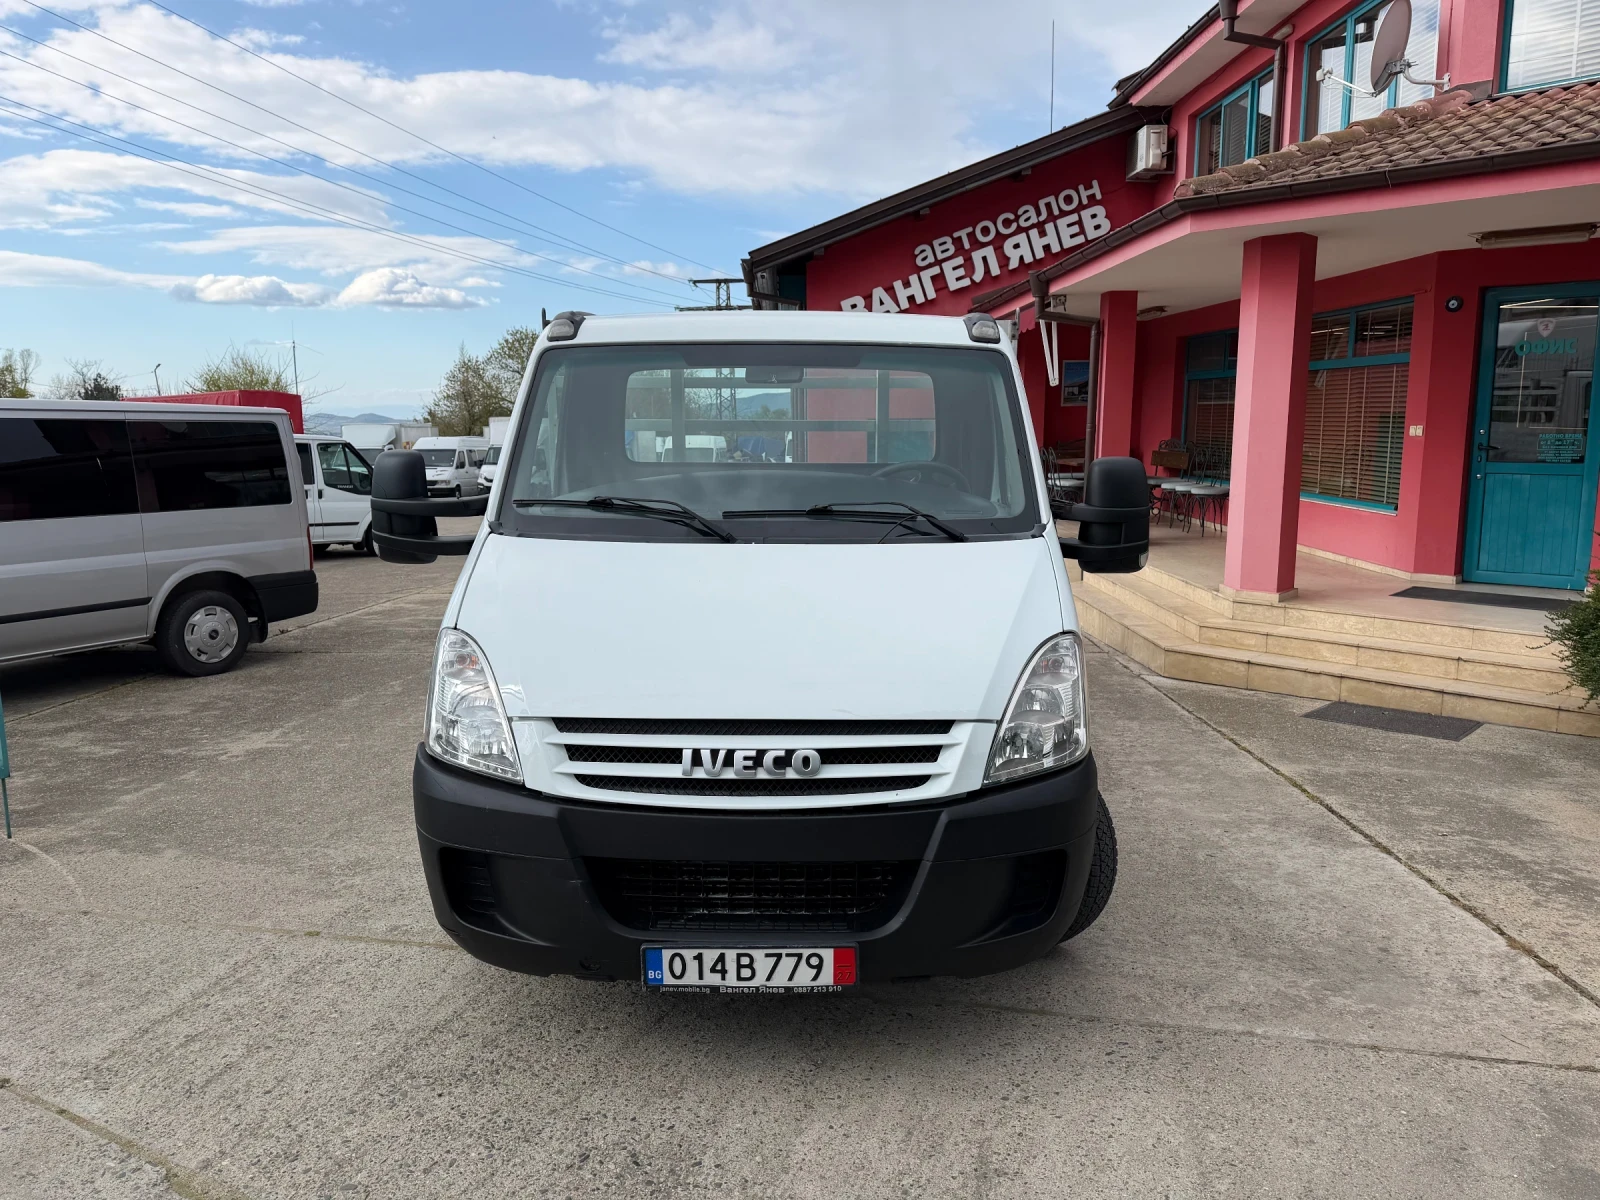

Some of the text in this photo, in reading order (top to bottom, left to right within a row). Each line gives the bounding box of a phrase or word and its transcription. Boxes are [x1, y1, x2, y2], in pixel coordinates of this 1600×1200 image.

[914, 179, 1103, 268] автосалон
[1004, 205, 1112, 270] ЯНЕВ
[1514, 338, 1577, 357] ОФИС
[682, 748, 822, 778] IVECO
[648, 970, 662, 979] BG
[719, 986, 756, 994] Вангел
[758, 985, 785, 994] Янев
